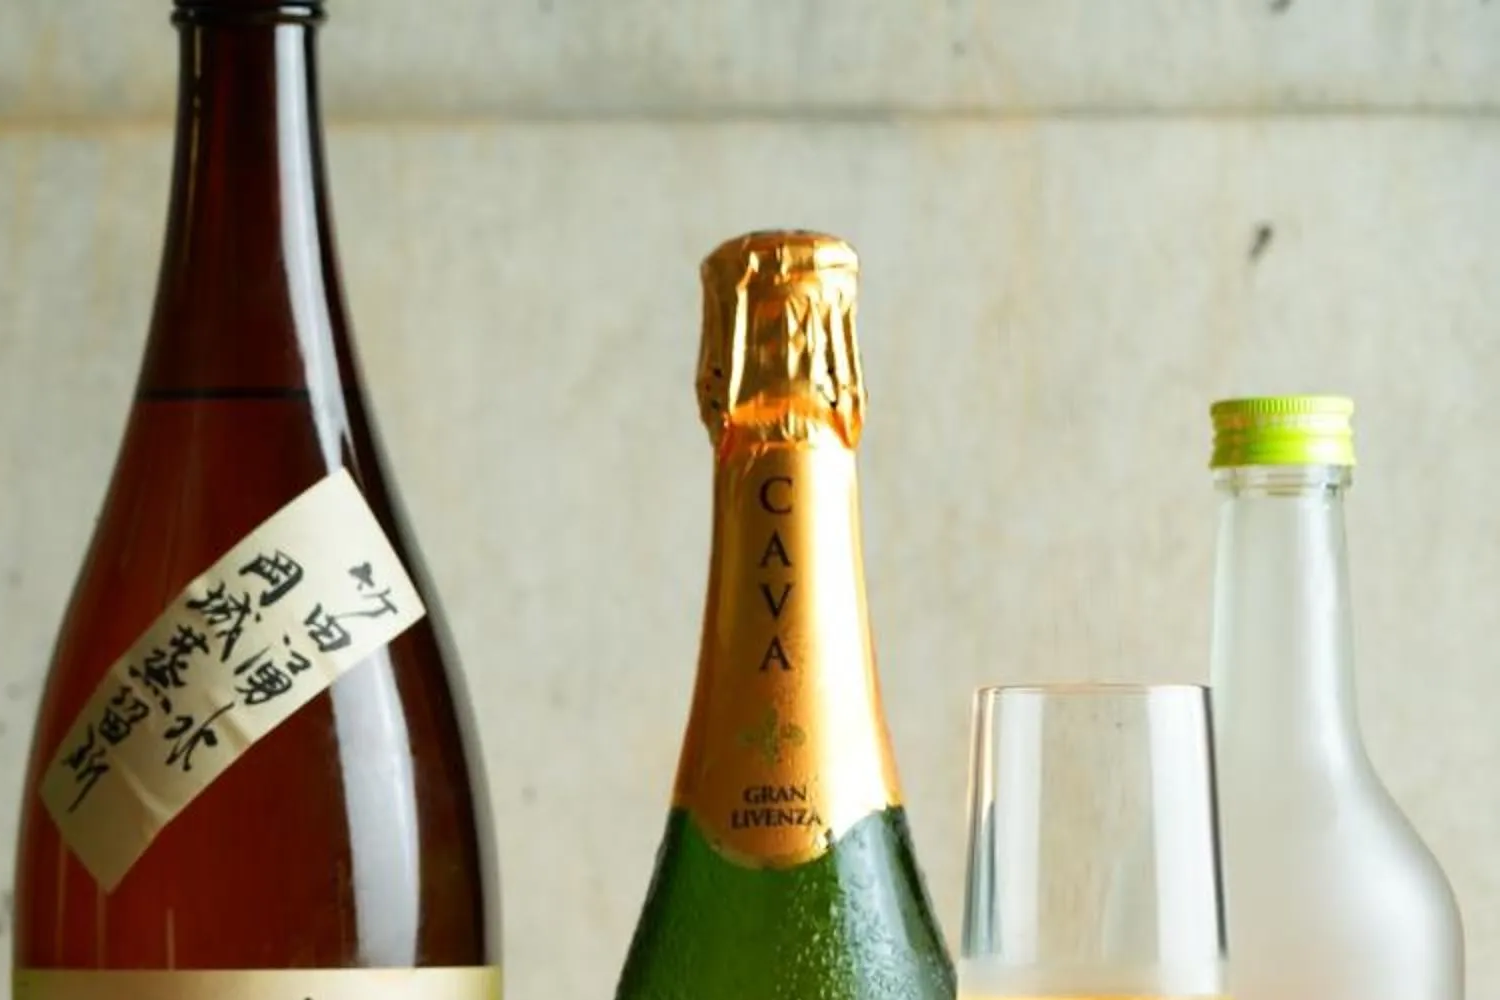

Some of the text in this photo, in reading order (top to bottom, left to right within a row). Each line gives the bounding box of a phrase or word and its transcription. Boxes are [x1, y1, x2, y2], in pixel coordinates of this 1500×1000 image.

[758, 476, 794, 673] CAVA
[743, 784, 808, 803] GRAN
[730, 808, 822, 831] LIVENZA
